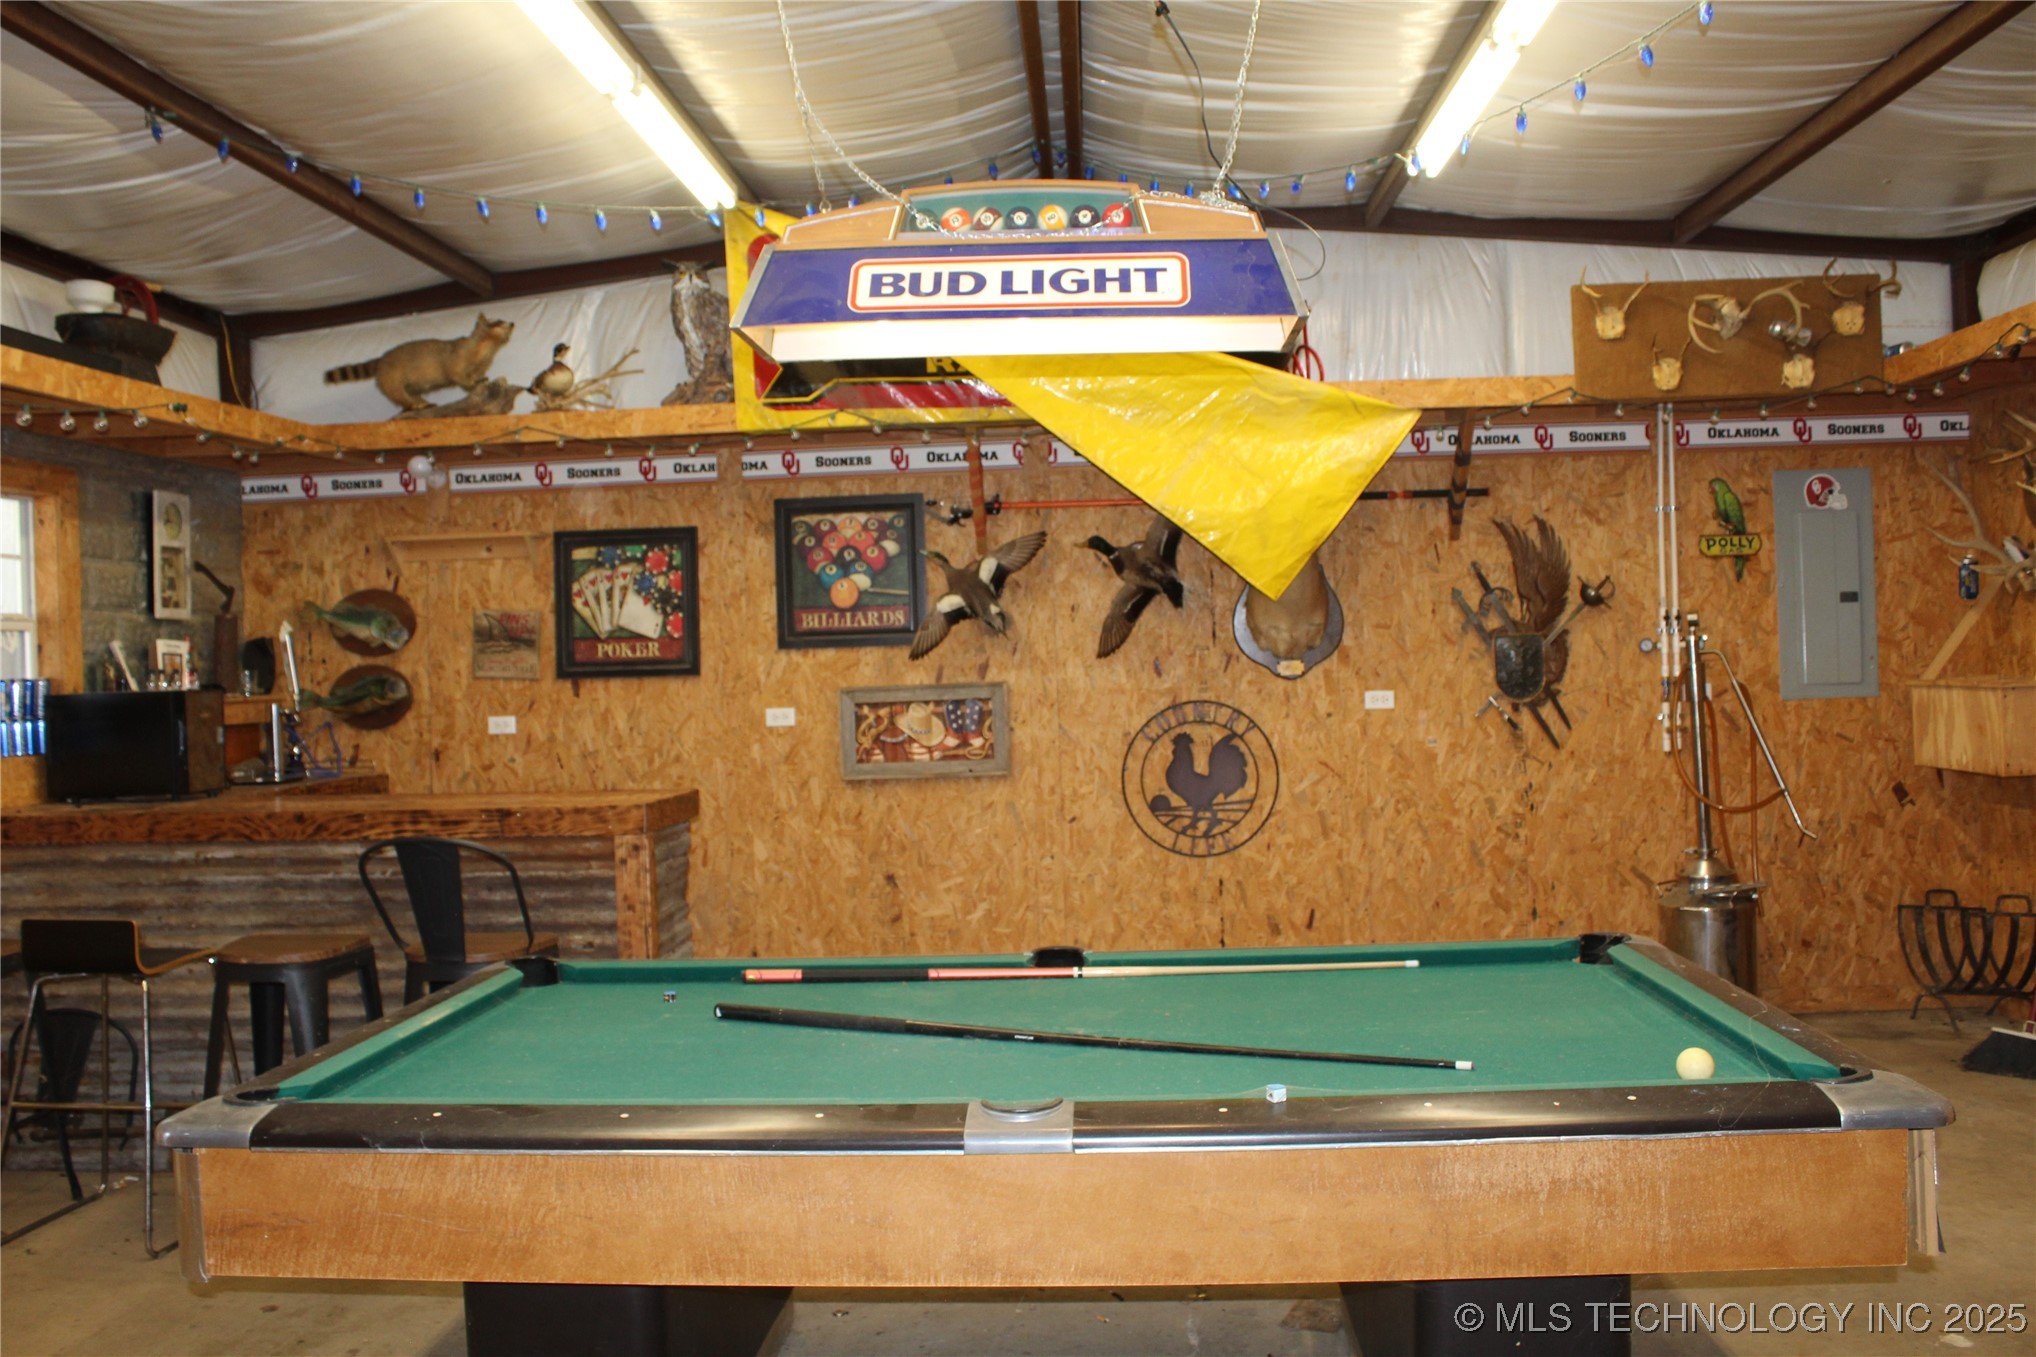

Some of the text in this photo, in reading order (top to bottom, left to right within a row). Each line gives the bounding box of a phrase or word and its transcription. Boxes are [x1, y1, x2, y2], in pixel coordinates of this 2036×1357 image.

[869, 267, 1168, 298] BUD LIGHT
[1569, 431, 1627, 443] SOONERS
[1707, 426, 1780, 439] OKLAHOMA
[1827, 423, 1885, 435] SOONERS
[815, 456, 872, 468] SOONERS
[455, 472, 522, 485] OKLAHOMA
[567, 468, 621, 479] SOONERS
[331, 479, 383, 491] SOONERS
[1706, 536, 1756, 551] POLLY
[801, 610, 906, 629] BILLIARDS
[596, 641, 661, 659] POKER
[1141, 701, 1257, 742] COUNTRY
